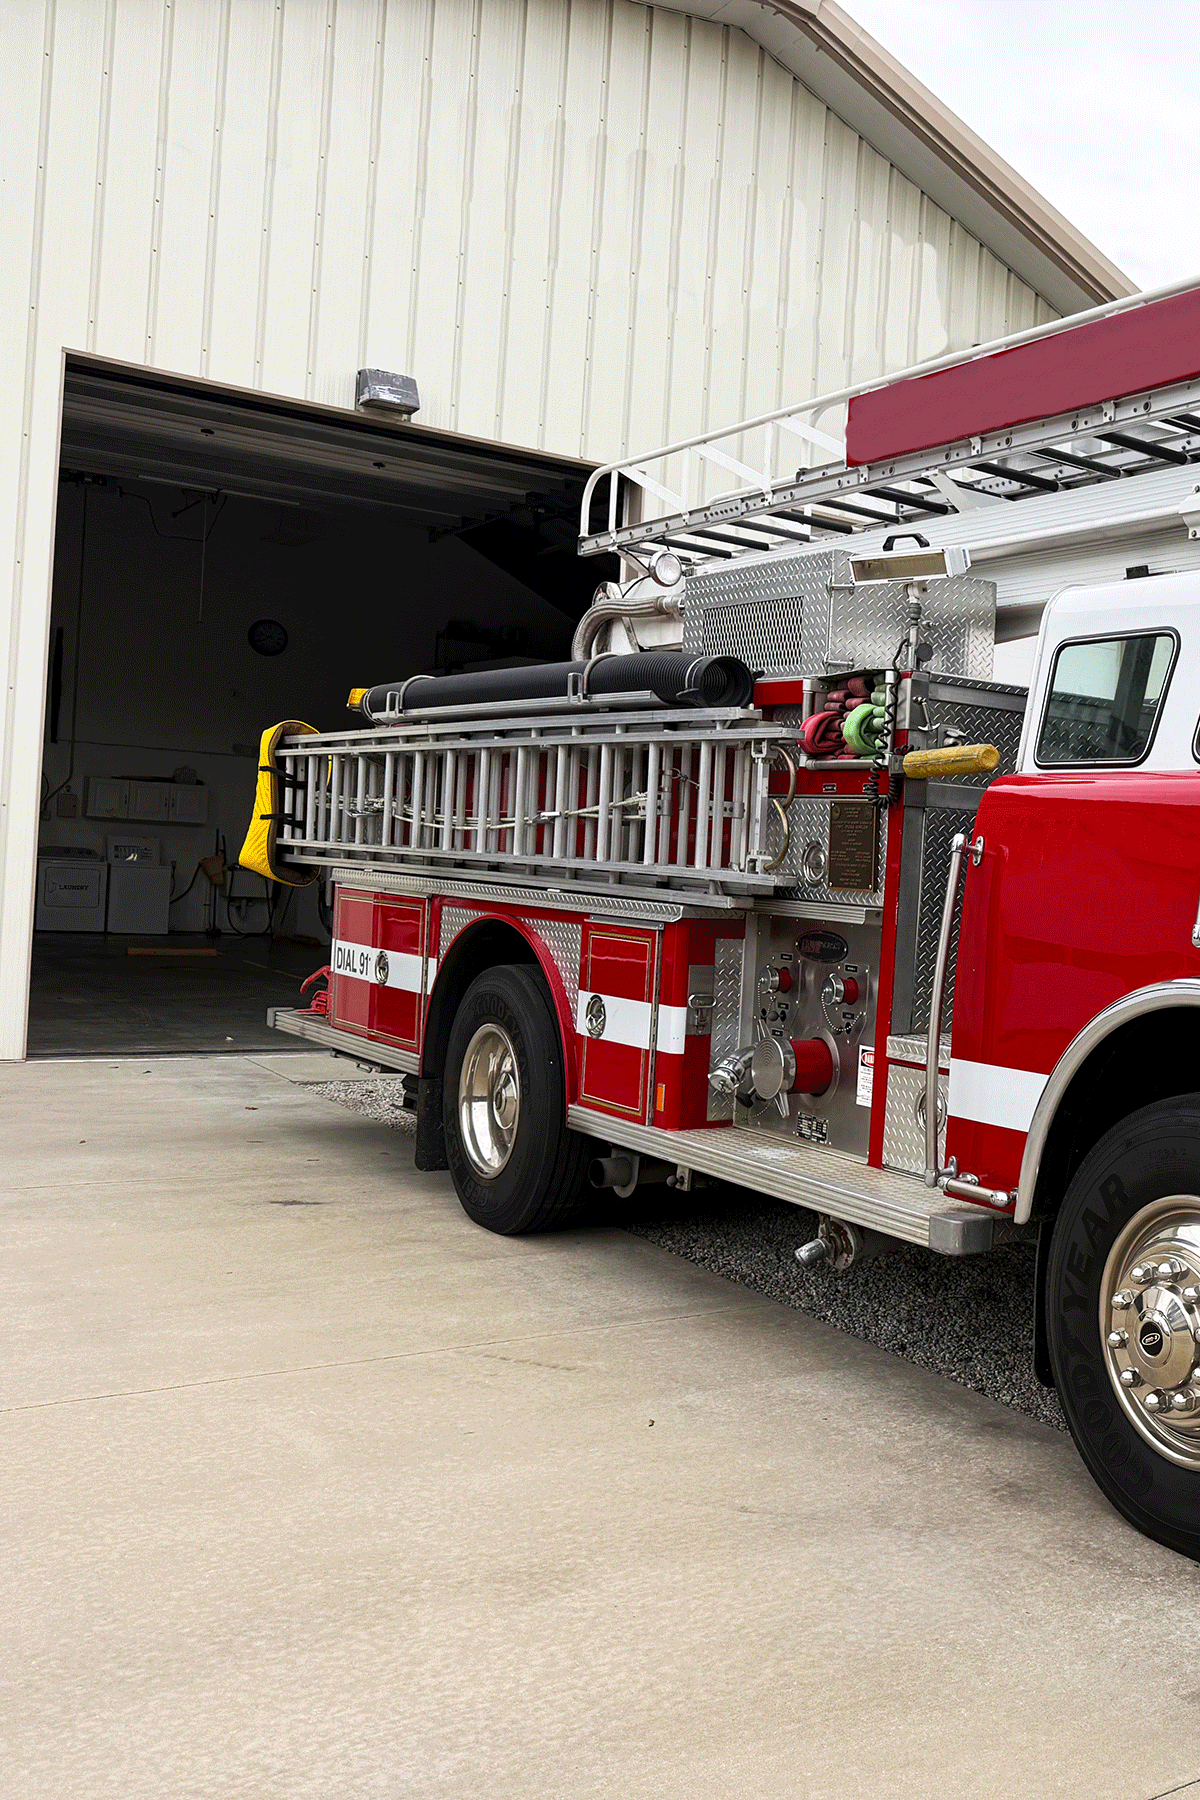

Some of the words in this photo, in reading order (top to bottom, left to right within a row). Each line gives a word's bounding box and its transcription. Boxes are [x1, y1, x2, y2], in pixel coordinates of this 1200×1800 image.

[336, 946, 357, 973] DIAL
[359, 951, 371, 976] 91
[1060, 1172, 1154, 1497] GOODYEAR
